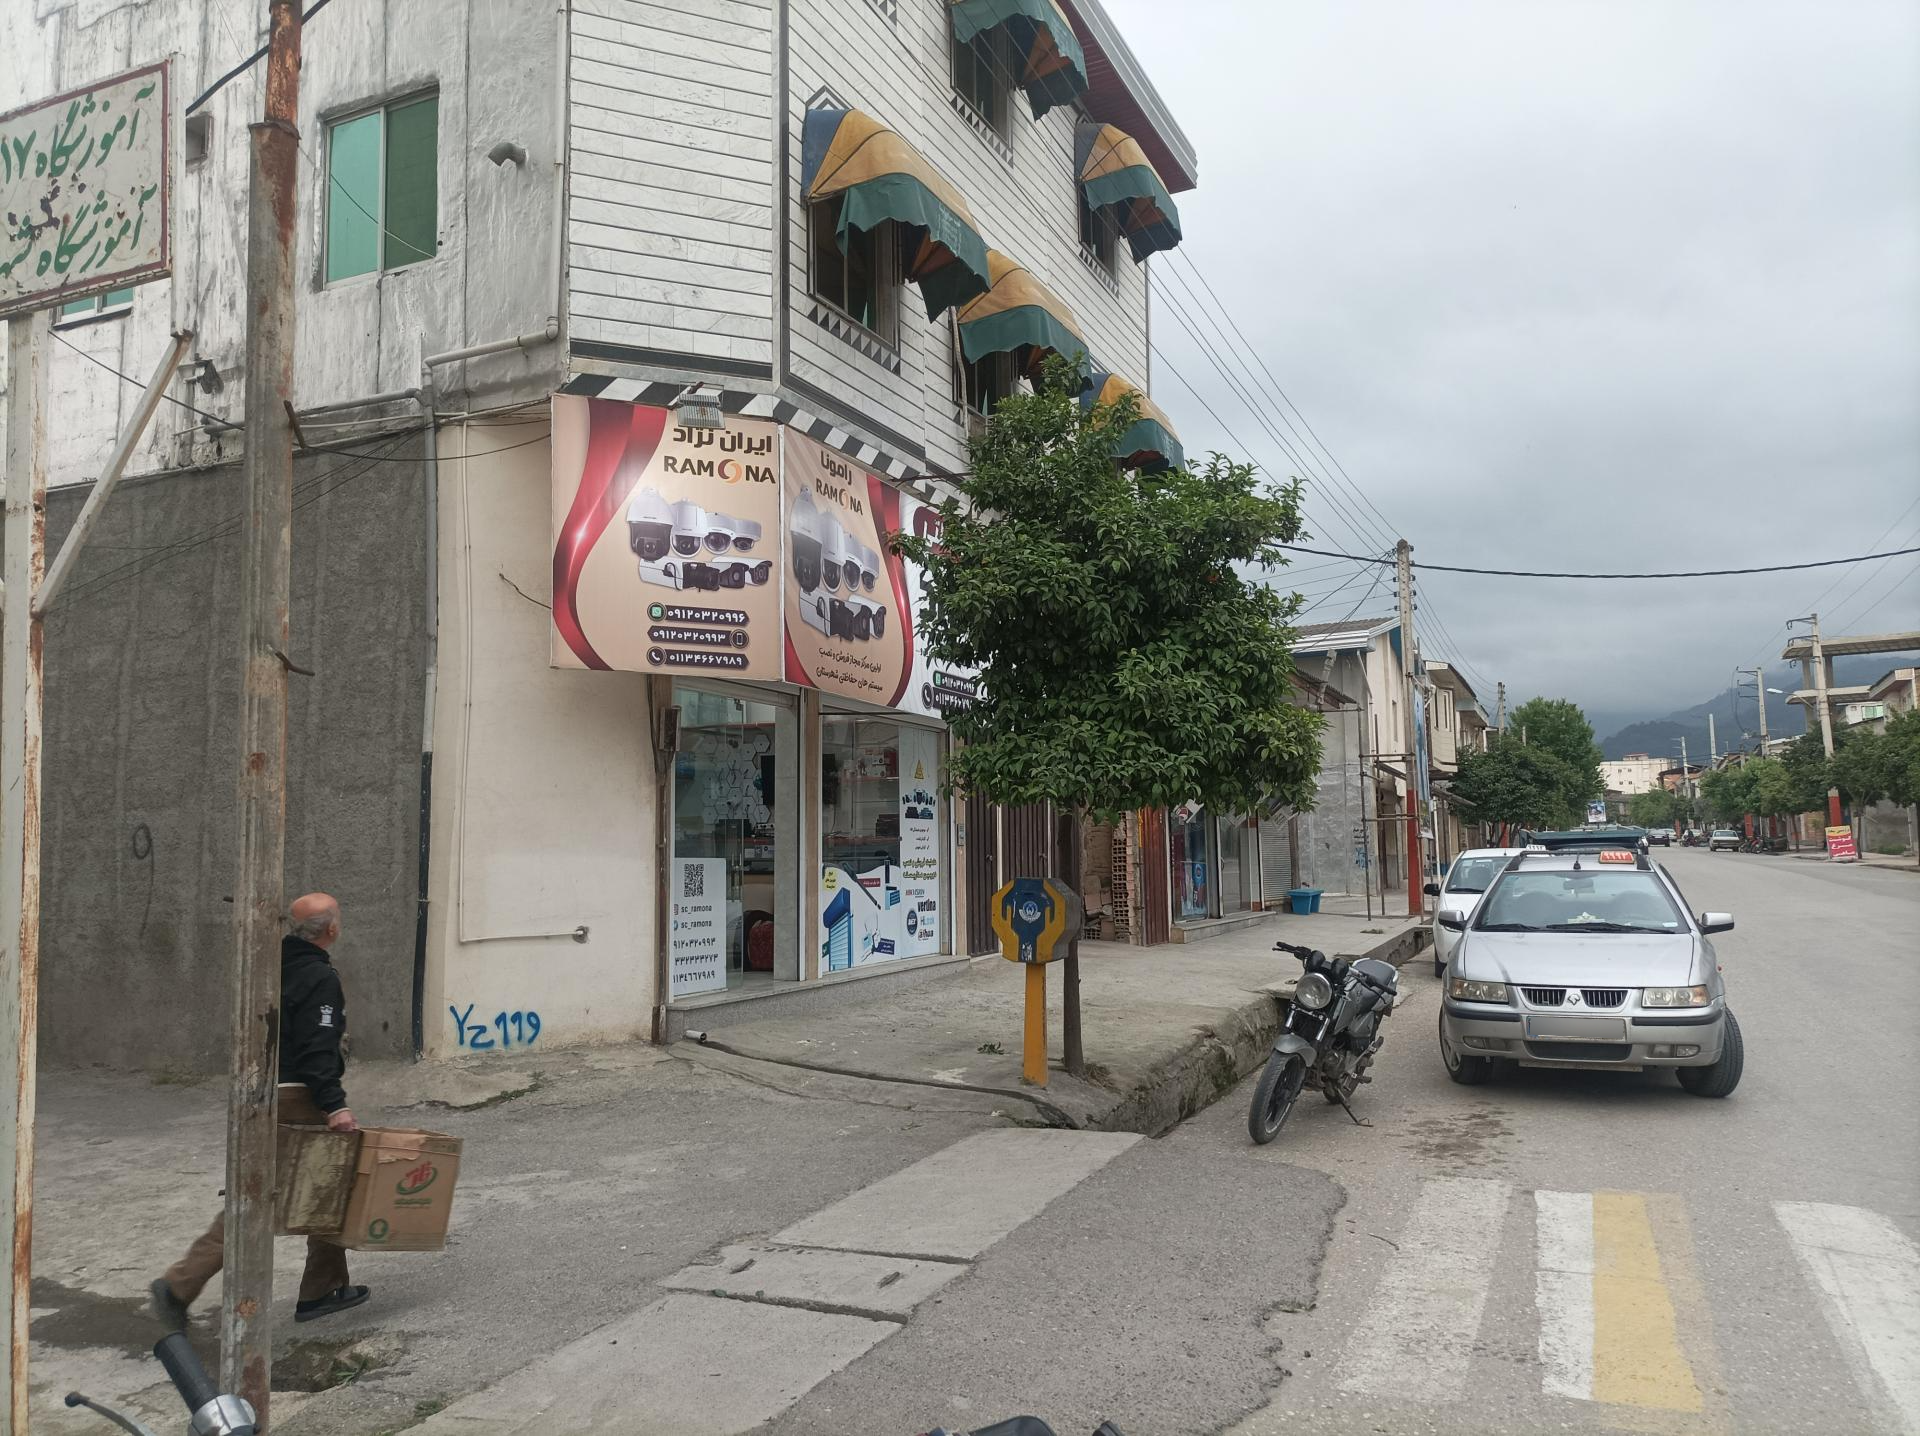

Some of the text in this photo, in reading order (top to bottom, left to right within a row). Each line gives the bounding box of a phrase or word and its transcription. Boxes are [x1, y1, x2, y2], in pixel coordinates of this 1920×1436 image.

[719, 430, 772, 456] ایران
[663, 455, 776, 484] RAMONA
[815, 477, 863, 515] RAMONA
